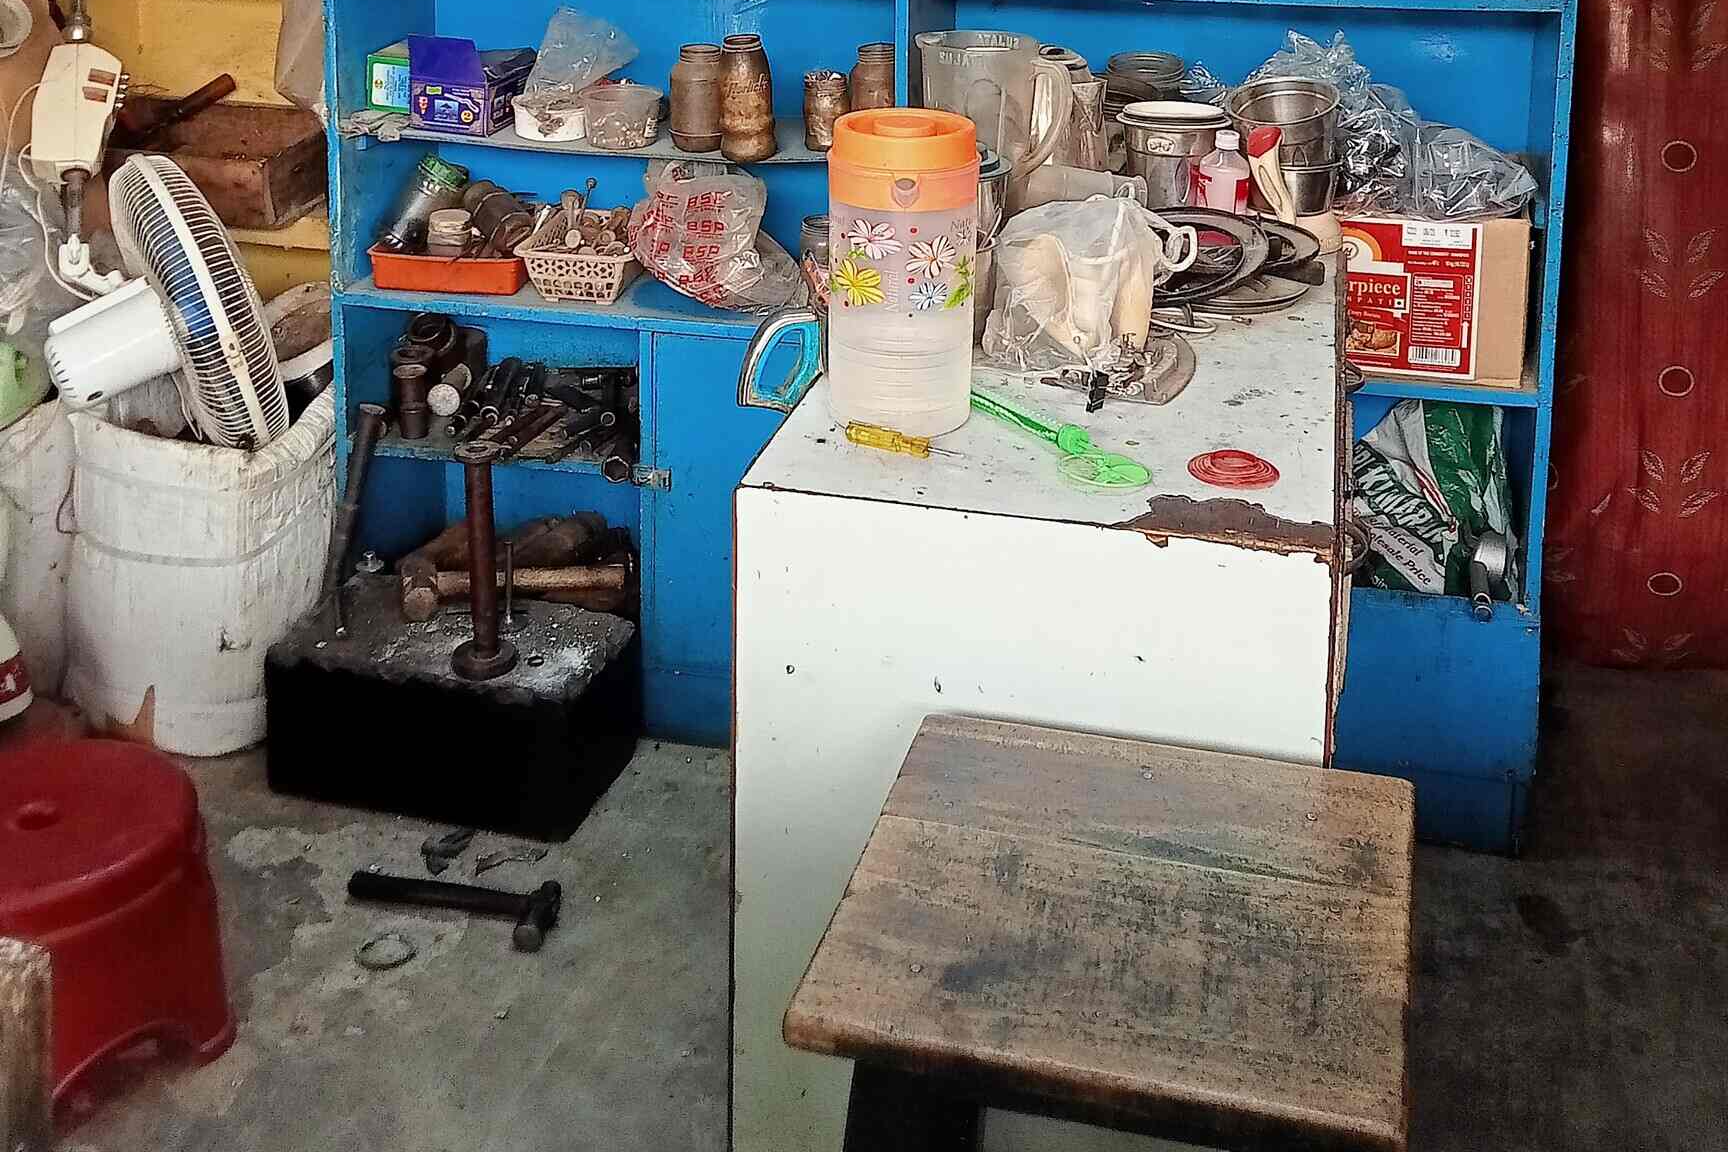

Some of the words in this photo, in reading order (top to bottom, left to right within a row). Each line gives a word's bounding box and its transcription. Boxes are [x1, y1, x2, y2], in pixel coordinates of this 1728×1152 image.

[687, 220, 725, 233] BSP
[683, 245, 721, 260] BSP
[1404, 559, 1432, 586] Price
